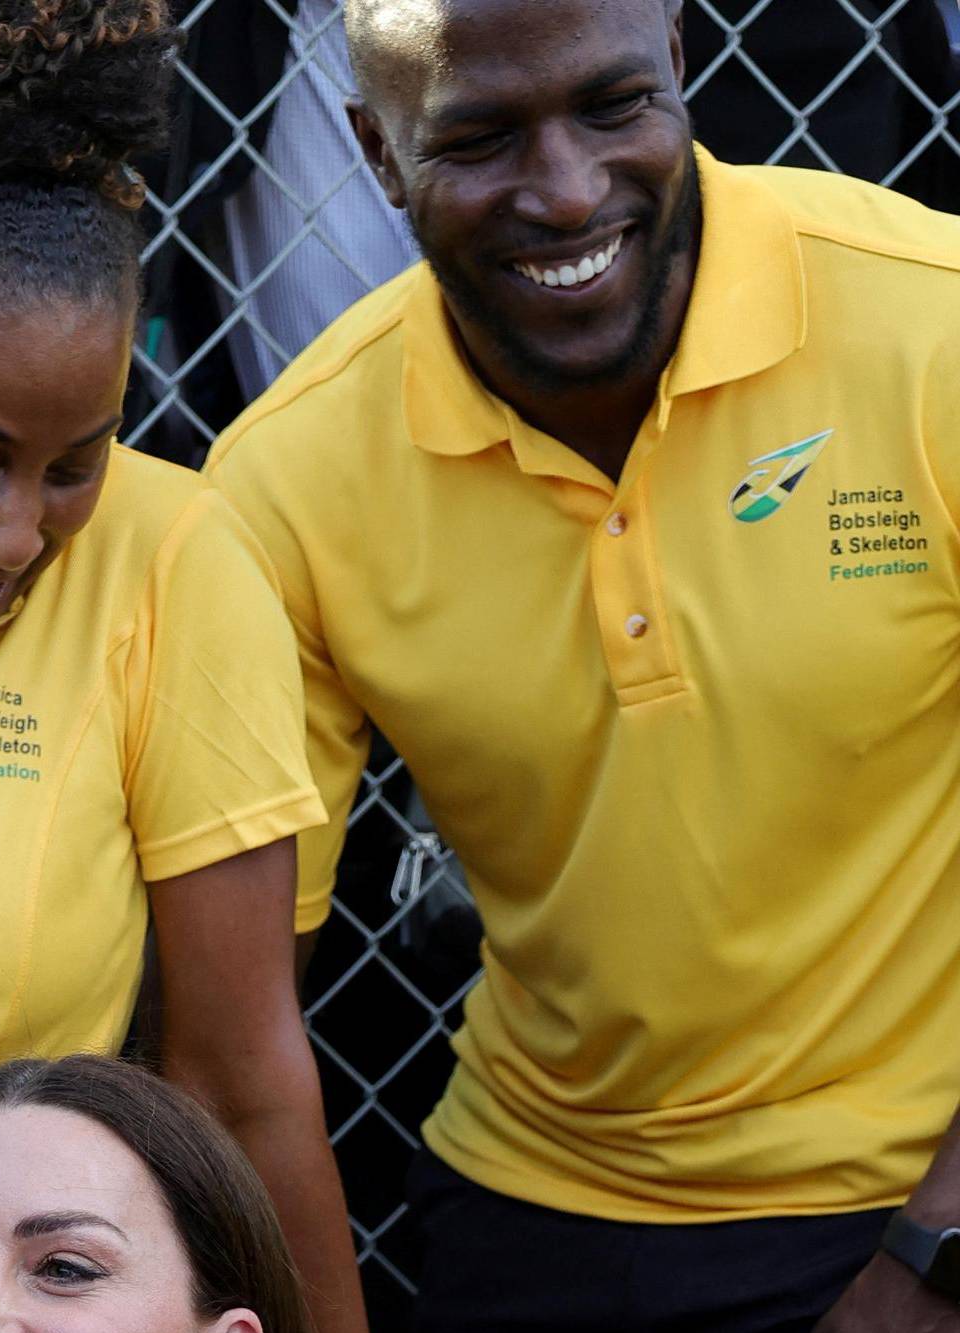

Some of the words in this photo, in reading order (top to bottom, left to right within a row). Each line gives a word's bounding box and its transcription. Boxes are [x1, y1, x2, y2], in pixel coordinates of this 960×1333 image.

[827, 485, 904, 506] Jamaica
[829, 510, 920, 531] Bobsleigh
[830, 539, 842, 555] &
[849, 535, 928, 553] Skeleton
[829, 560, 928, 580] Federation
